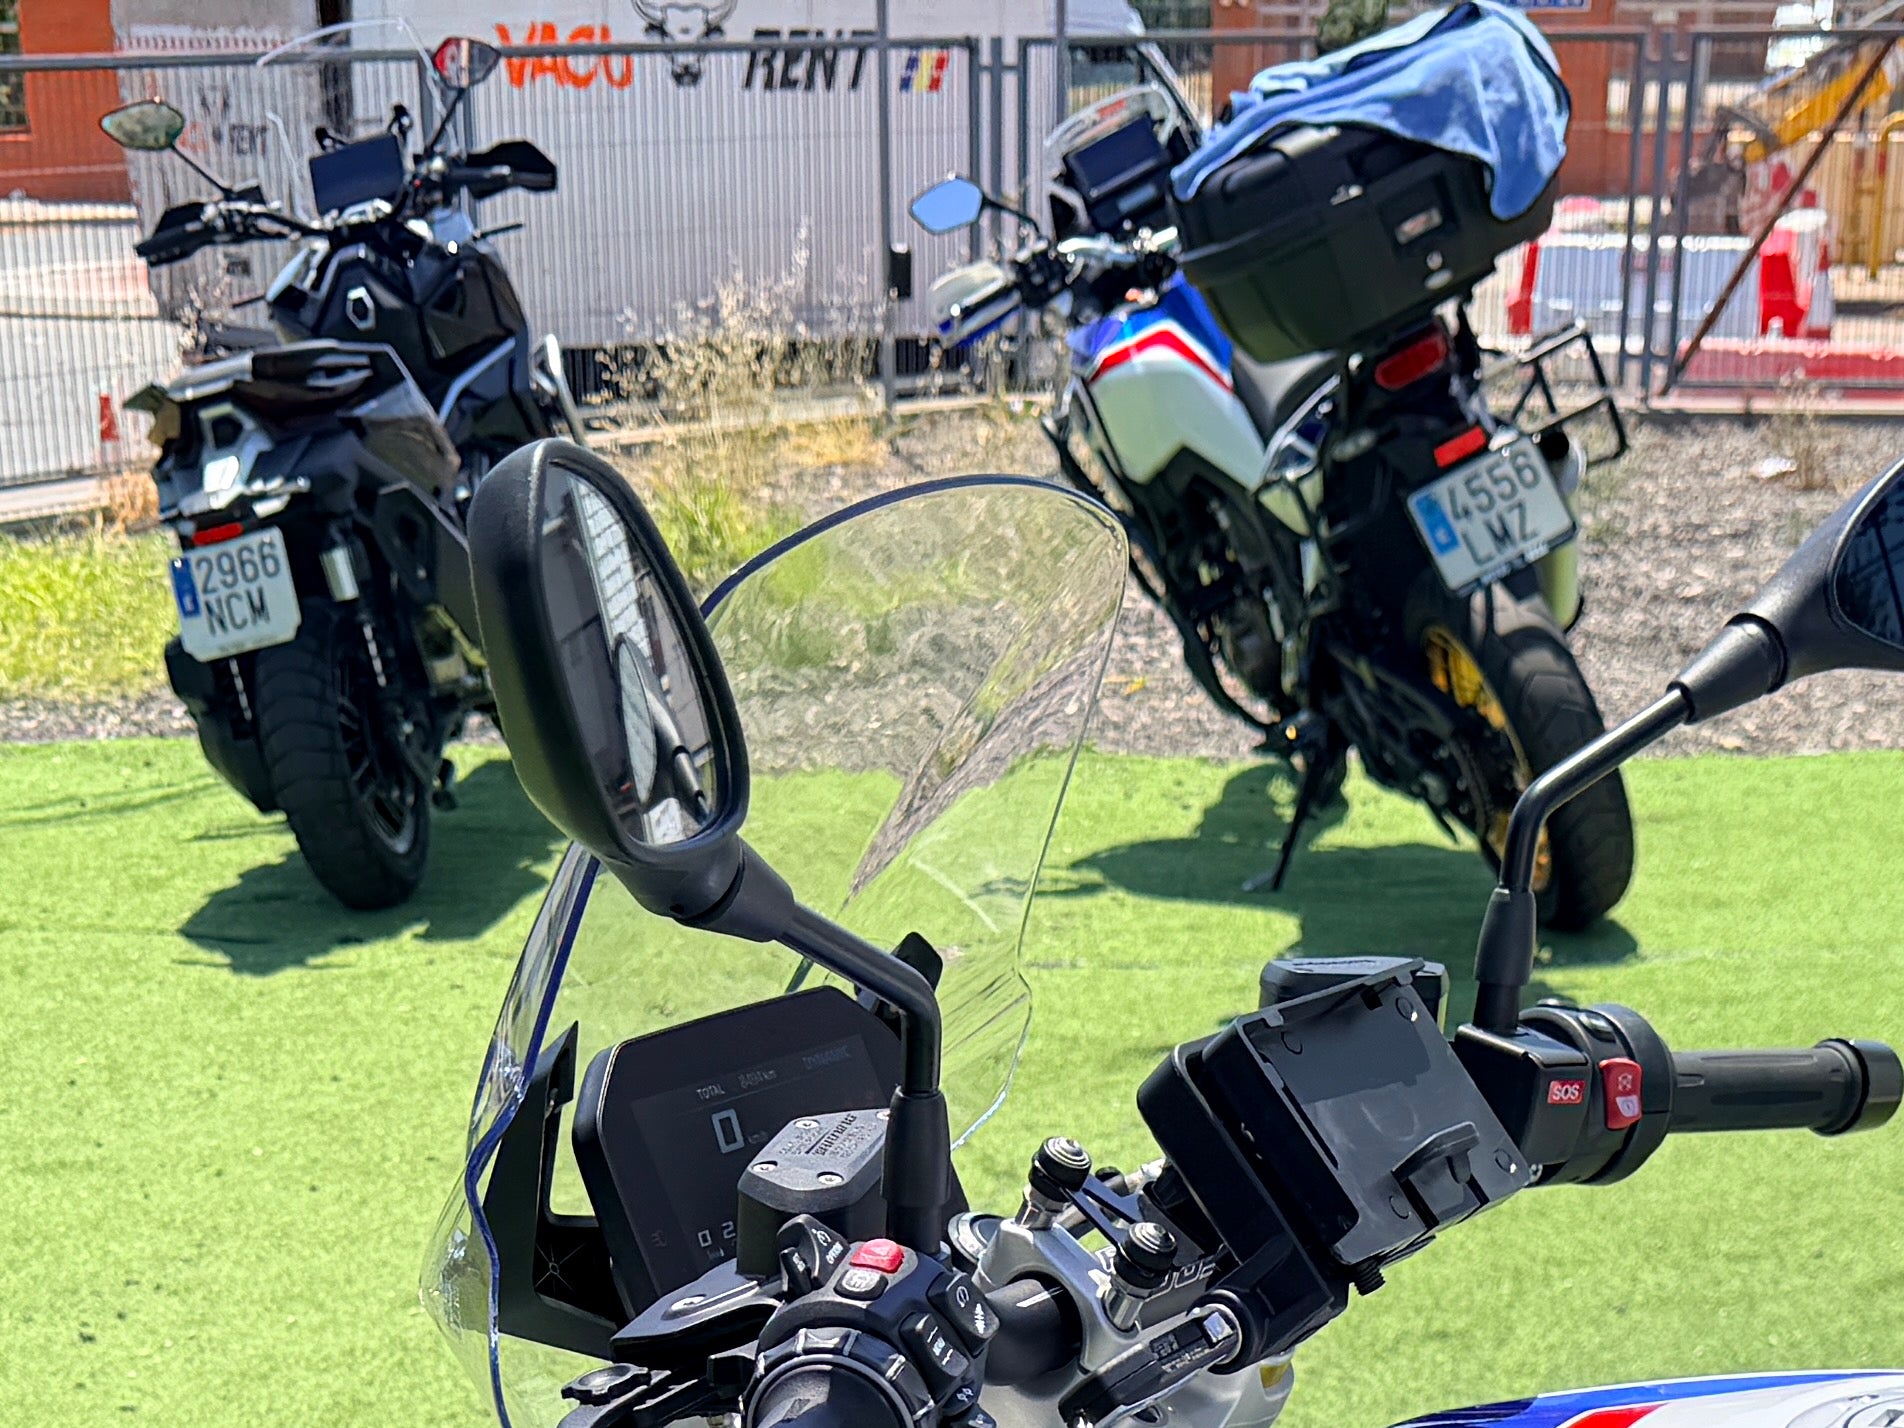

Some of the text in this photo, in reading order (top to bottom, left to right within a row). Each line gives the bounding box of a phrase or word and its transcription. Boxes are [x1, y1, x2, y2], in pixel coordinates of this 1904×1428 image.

[494, 22, 878, 91] VACU RENT
[1448, 451, 1541, 521] 4556
[195, 540, 281, 595] 2966
[1552, 1084, 1580, 1101] SOS
